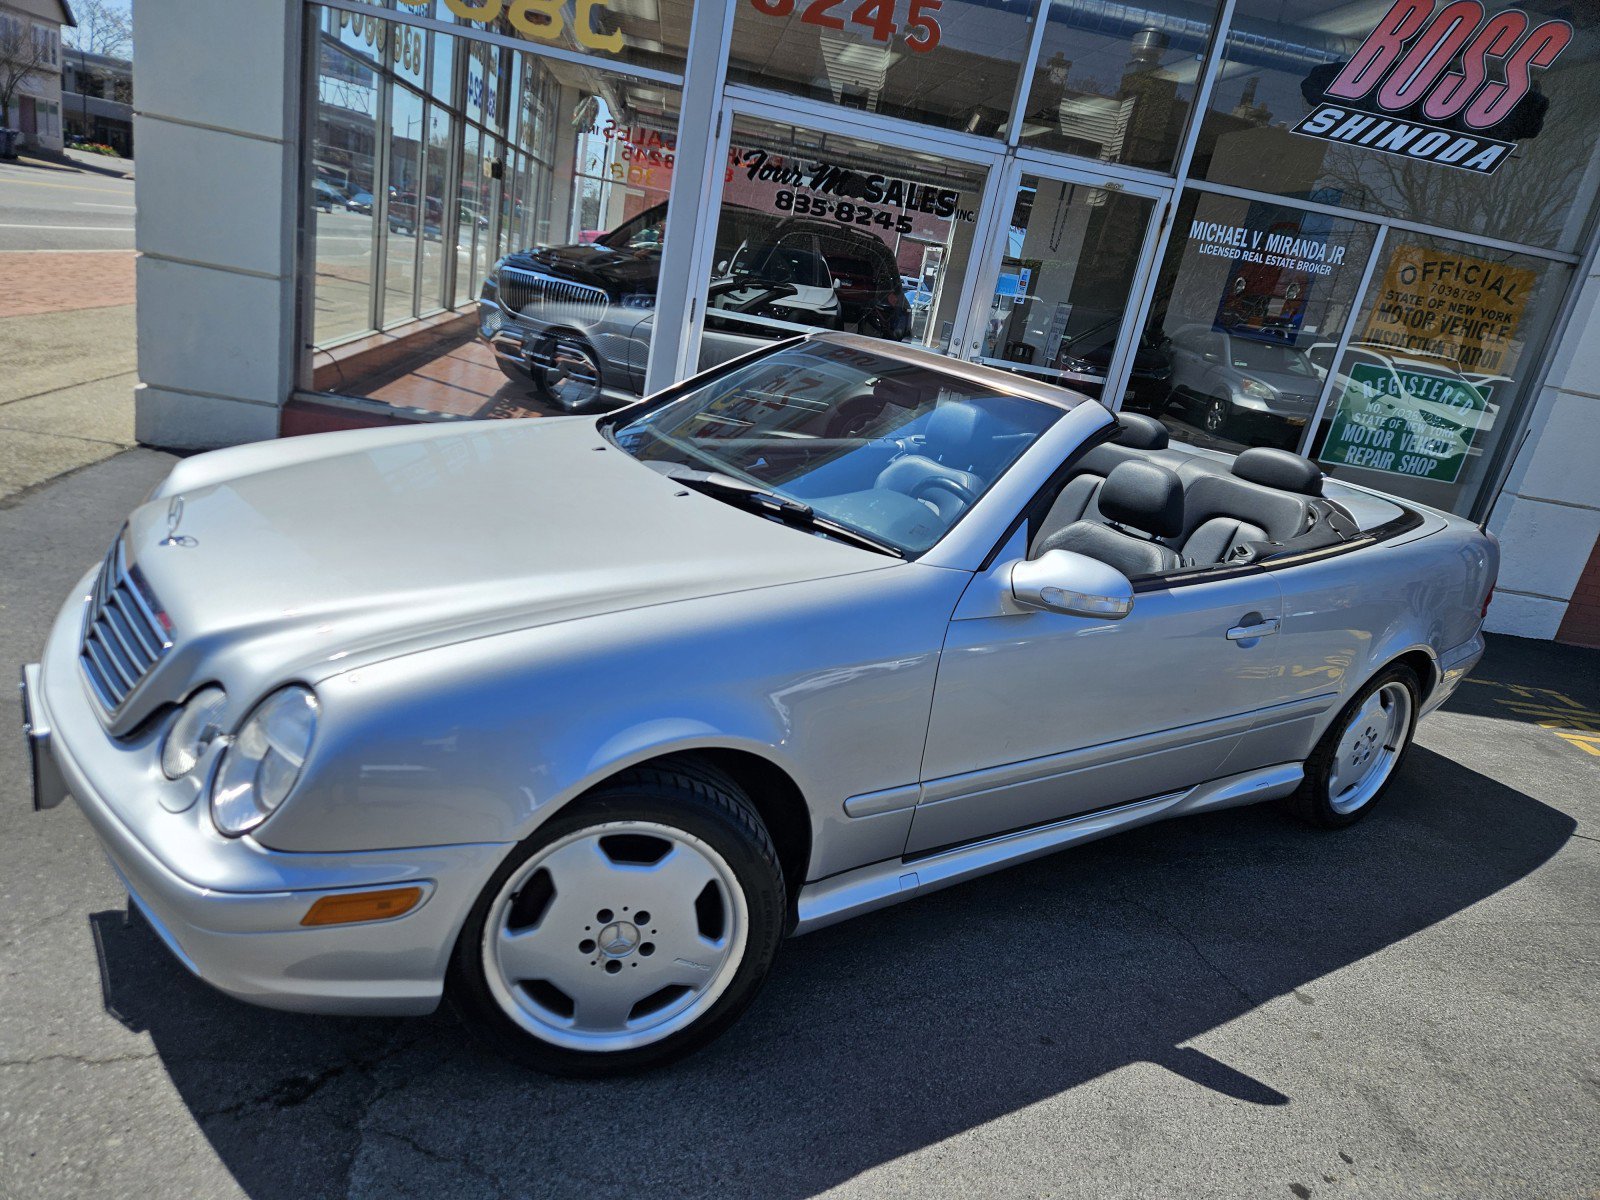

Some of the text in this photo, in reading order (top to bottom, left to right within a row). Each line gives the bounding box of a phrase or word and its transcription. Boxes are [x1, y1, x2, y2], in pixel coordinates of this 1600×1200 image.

[1325, 0, 1573, 129] BOSS
[1302, 109, 1506, 170] SHINODA
[863, 174, 960, 218] SALES
[956, 208, 975, 223] INC.
[1189, 219, 1346, 266] MICHAEL V. MIRANDA JR.
[1199, 243, 1332, 276] LICENSED REAL ESTATE BROKER
[1400, 261, 1517, 305] OFFICIAL
[1431, 283, 1482, 302] 7038729
[1377, 303, 1511, 345] MOTOR VEHICLE
[1385, 290, 1513, 323] STATE OF NEW YORK
[1362, 375, 1474, 416] REGISTERED
[1365, 403, 1383, 414] NO.
[1341, 423, 1458, 459] MOTOR VEHICLE
[1352, 412, 1456, 438] STATE OF NEW YORK
[1344, 445, 1438, 476] REPAIR SHOP
